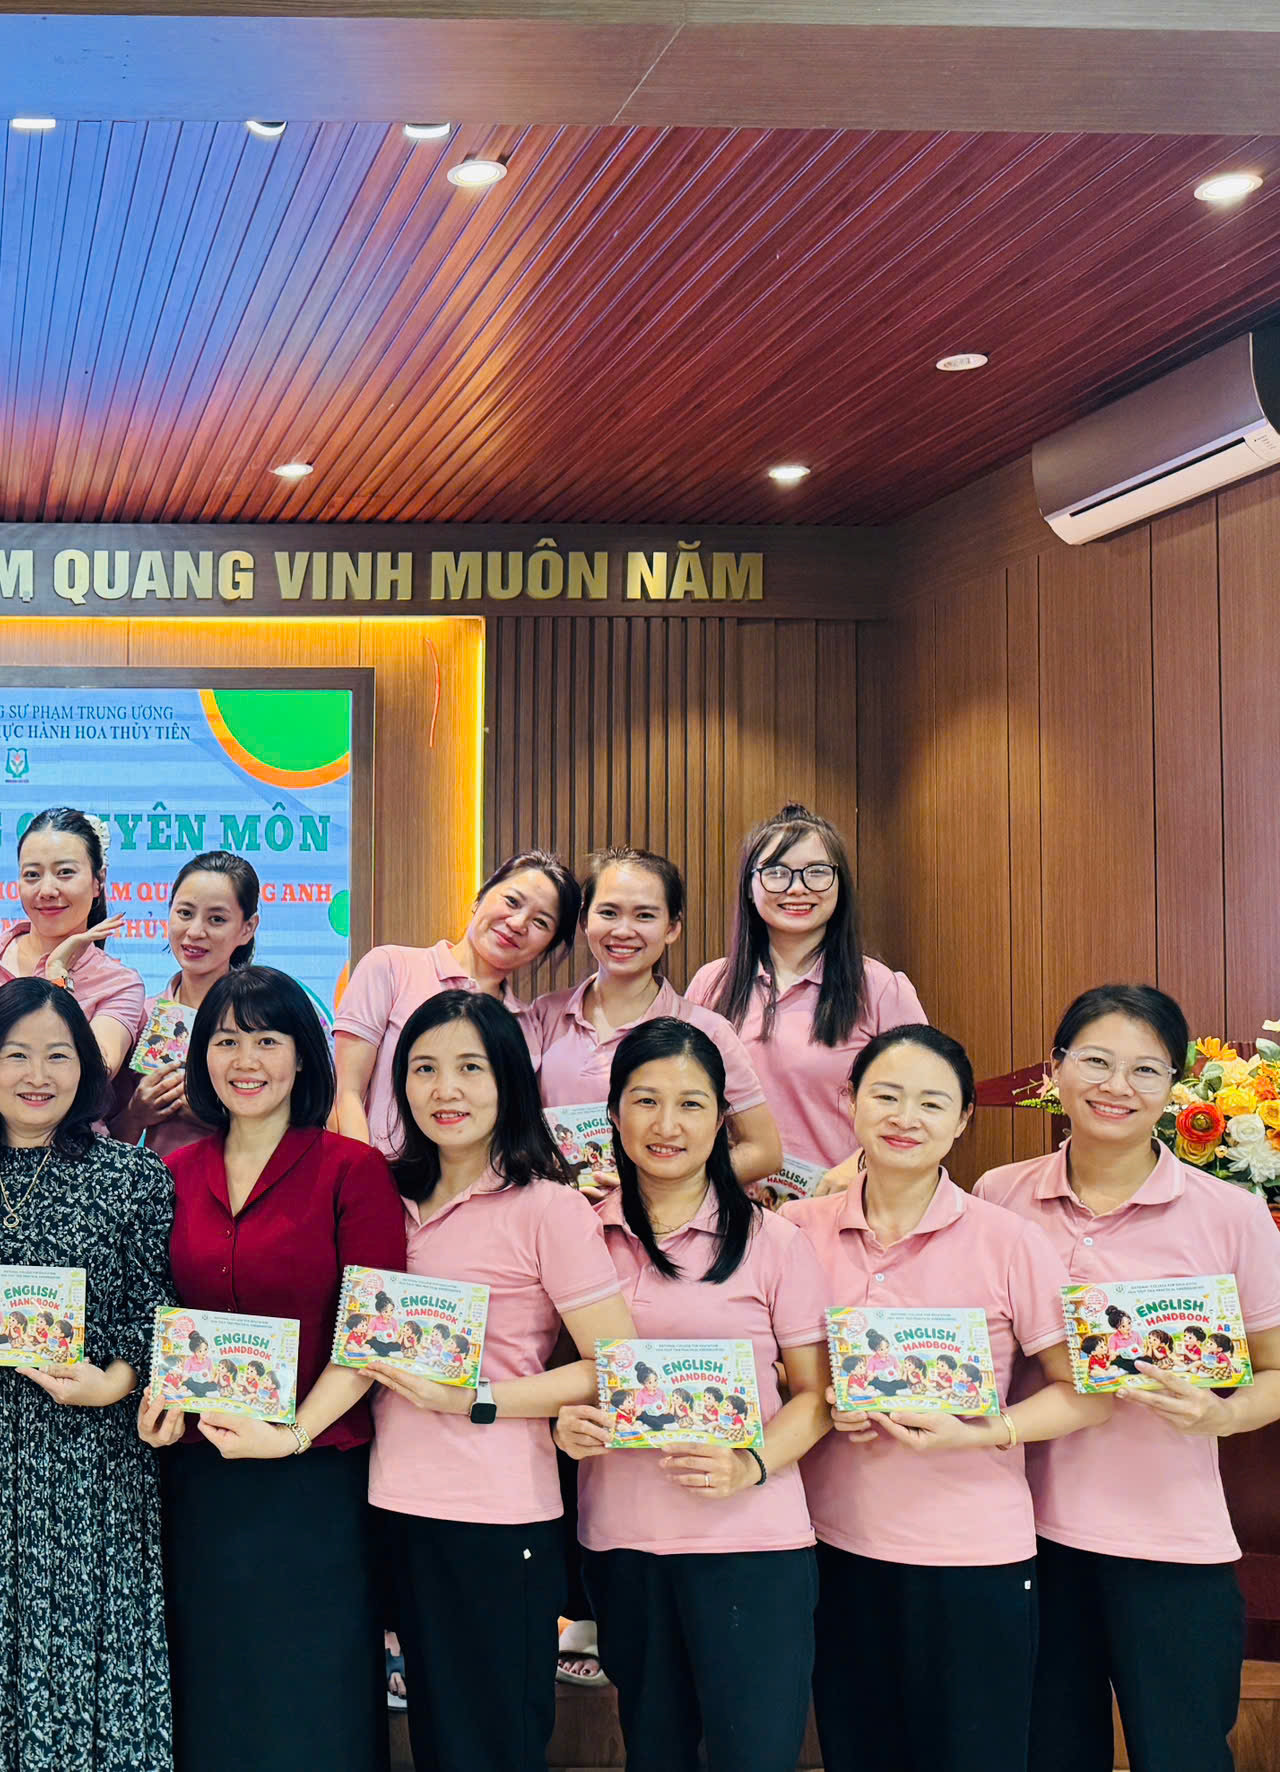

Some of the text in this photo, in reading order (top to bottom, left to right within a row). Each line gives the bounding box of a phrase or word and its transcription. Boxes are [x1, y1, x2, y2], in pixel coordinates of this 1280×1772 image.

[53, 549, 255, 605] QUANG
[274, 551, 413, 600] VINH
[431, 537, 610, 600] MUÔN
[627, 541, 765, 600] NĂM
[32, 705, 73, 721] PHẠM
[77, 705, 127, 720] TRUNG
[132, 703, 173, 720] ƯƠNG
[28, 720, 70, 739] HÀNH
[75, 725, 107, 739] HOA
[110, 722, 152, 740] THỦY
[155, 722, 190, 740] TIÊN
[219, 802, 329, 852] MÔN
[281, 883, 333, 902] ANH
[576, 1118, 611, 1133] ENGL
[776, 1168, 808, 1187] GLISH
[4, 1285, 58, 1299] ENGLISH
[400, 1295, 457, 1313] ENGLISH
[1136, 1298, 1205, 1318] ENGLISH
[406, 1308, 458, 1325] HANDBOOK
[1145, 1312, 1210, 1327] HANDBOOK
[213, 1332, 270, 1349] ENGLISH
[894, 1327, 957, 1343] ENGLISH
[220, 1347, 272, 1361] HANDBOOK
[903, 1341, 962, 1354] HANDBOOK
[663, 1359, 724, 1376] ENGLISH
[671, 1372, 728, 1385] HANDBOOK
